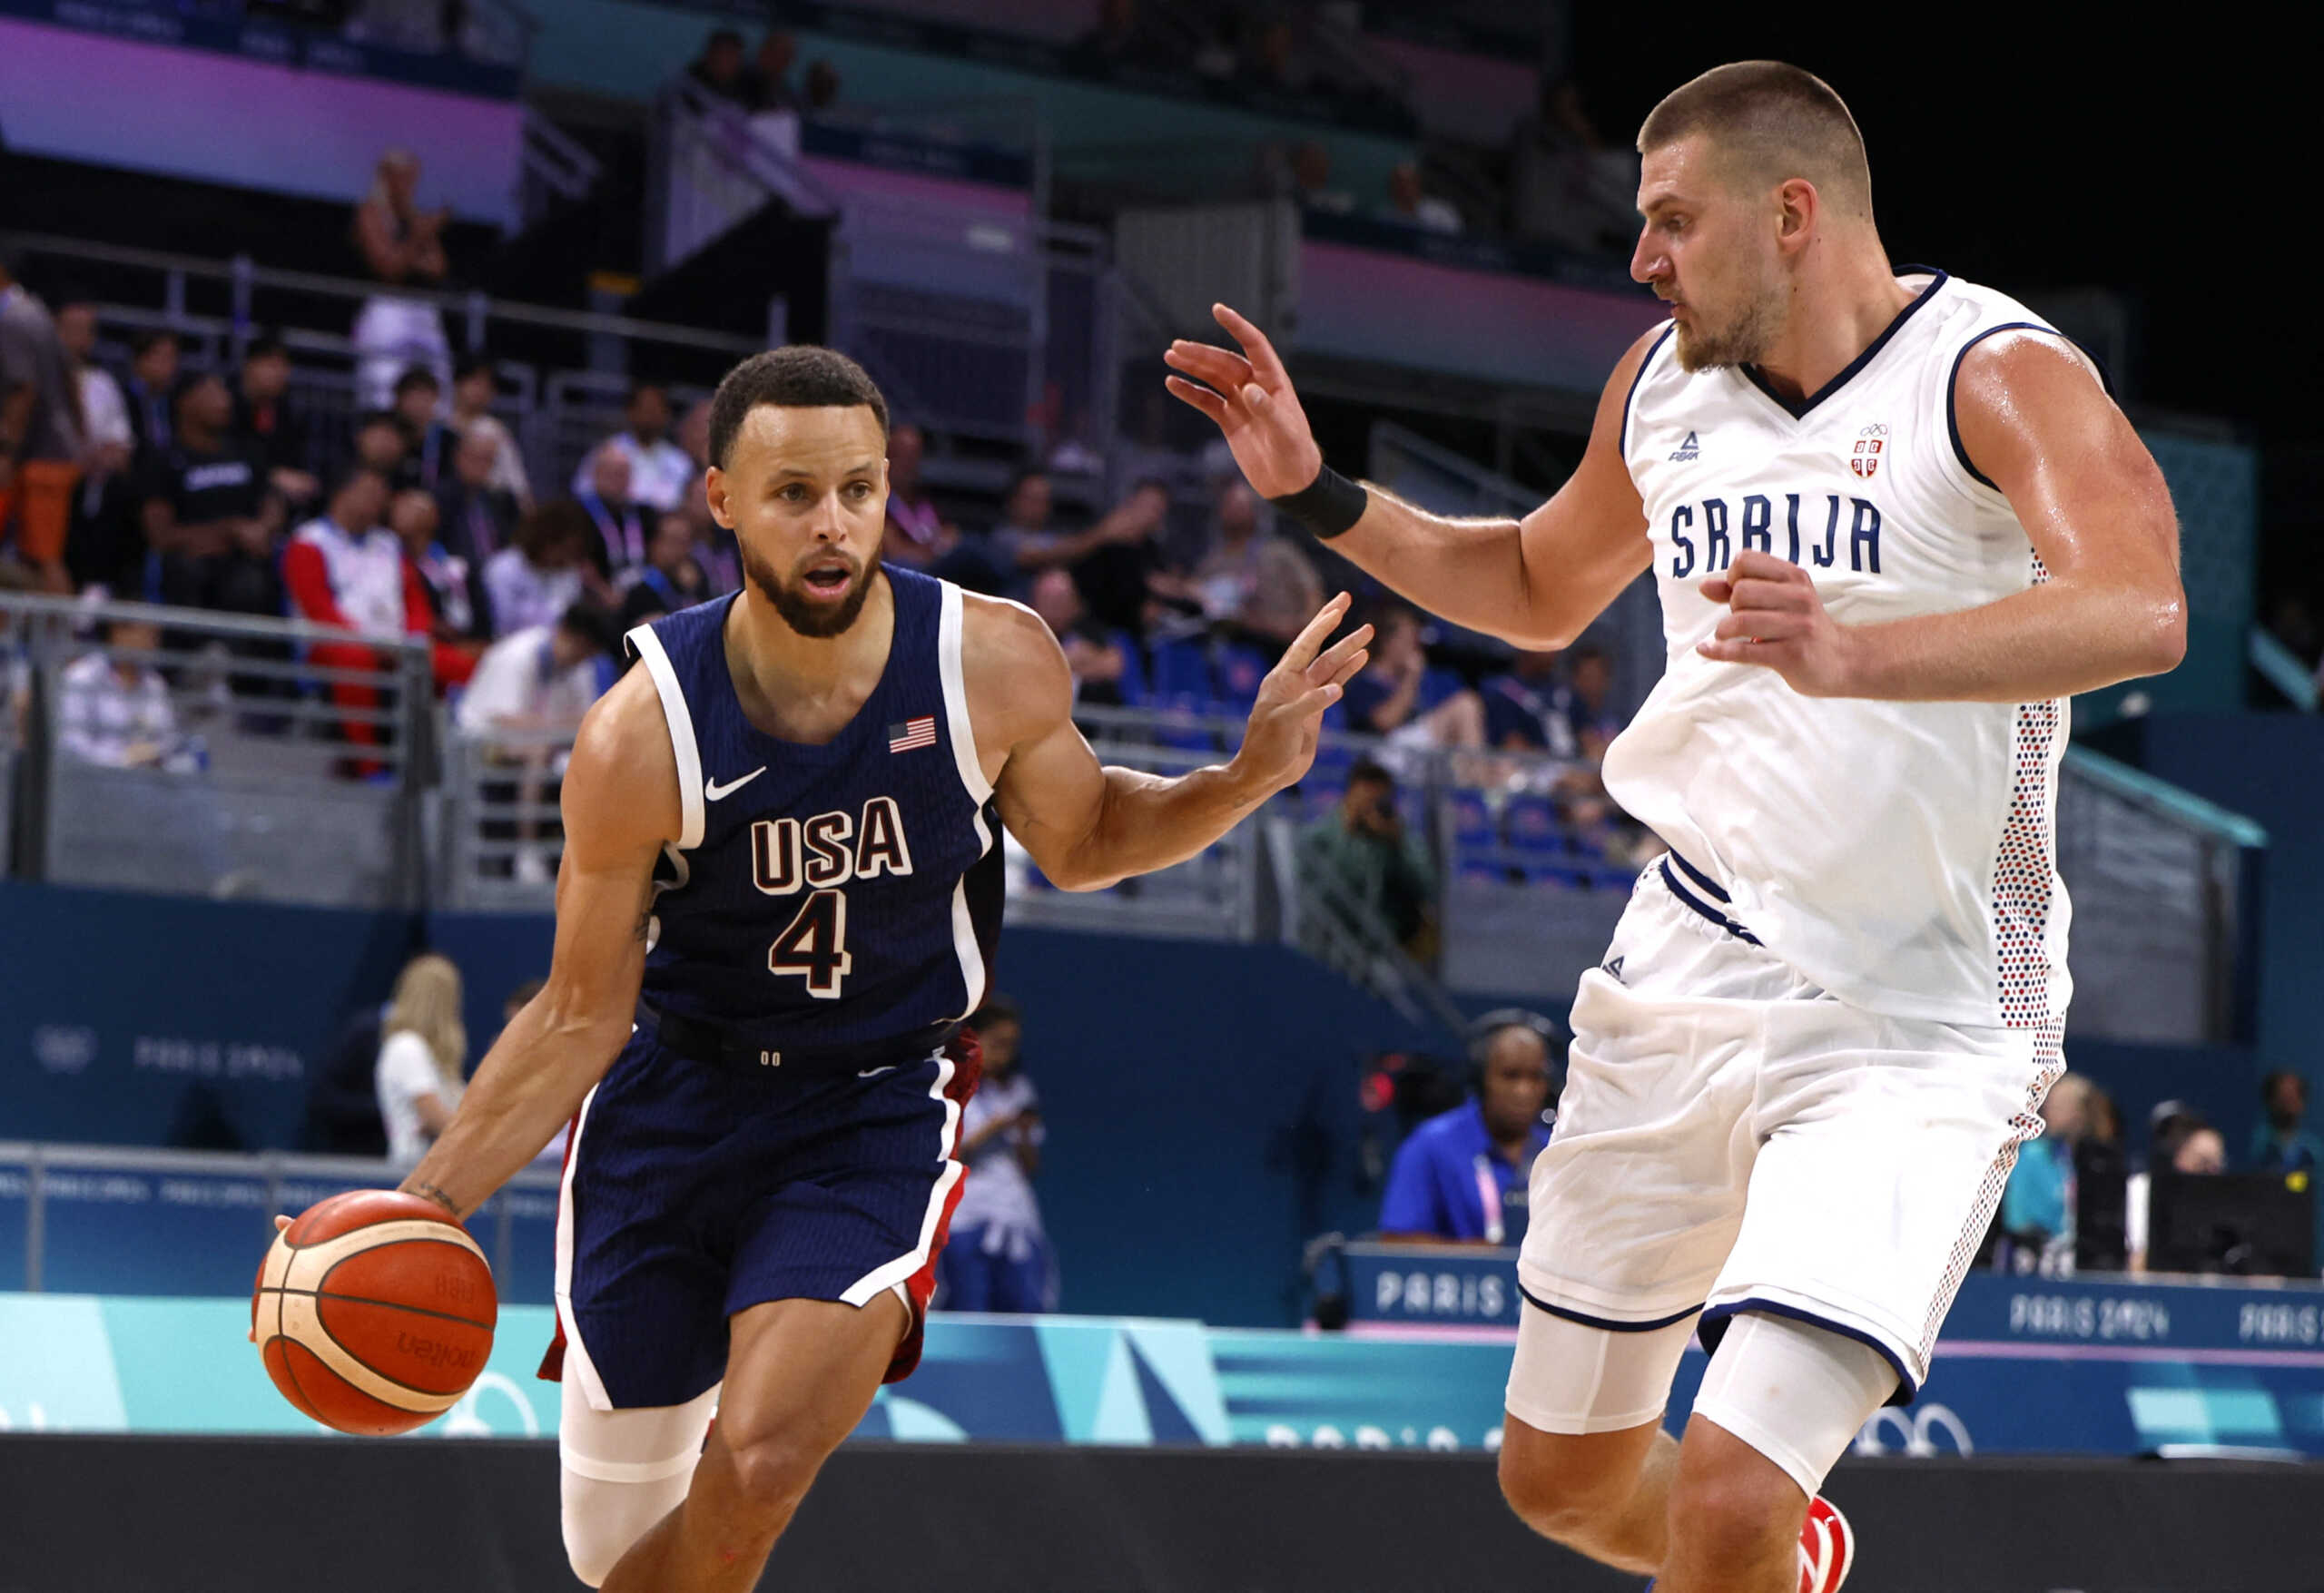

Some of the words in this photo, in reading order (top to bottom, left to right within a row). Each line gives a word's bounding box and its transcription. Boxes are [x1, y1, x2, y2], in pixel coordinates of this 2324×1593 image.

[1671, 493, 1881, 578] SRBIJA
[751, 795, 913, 895] USA
[768, 888, 852, 999] 4
[1376, 1271, 1505, 1317] PARIS
[2010, 1293, 2096, 1339] PARIS
